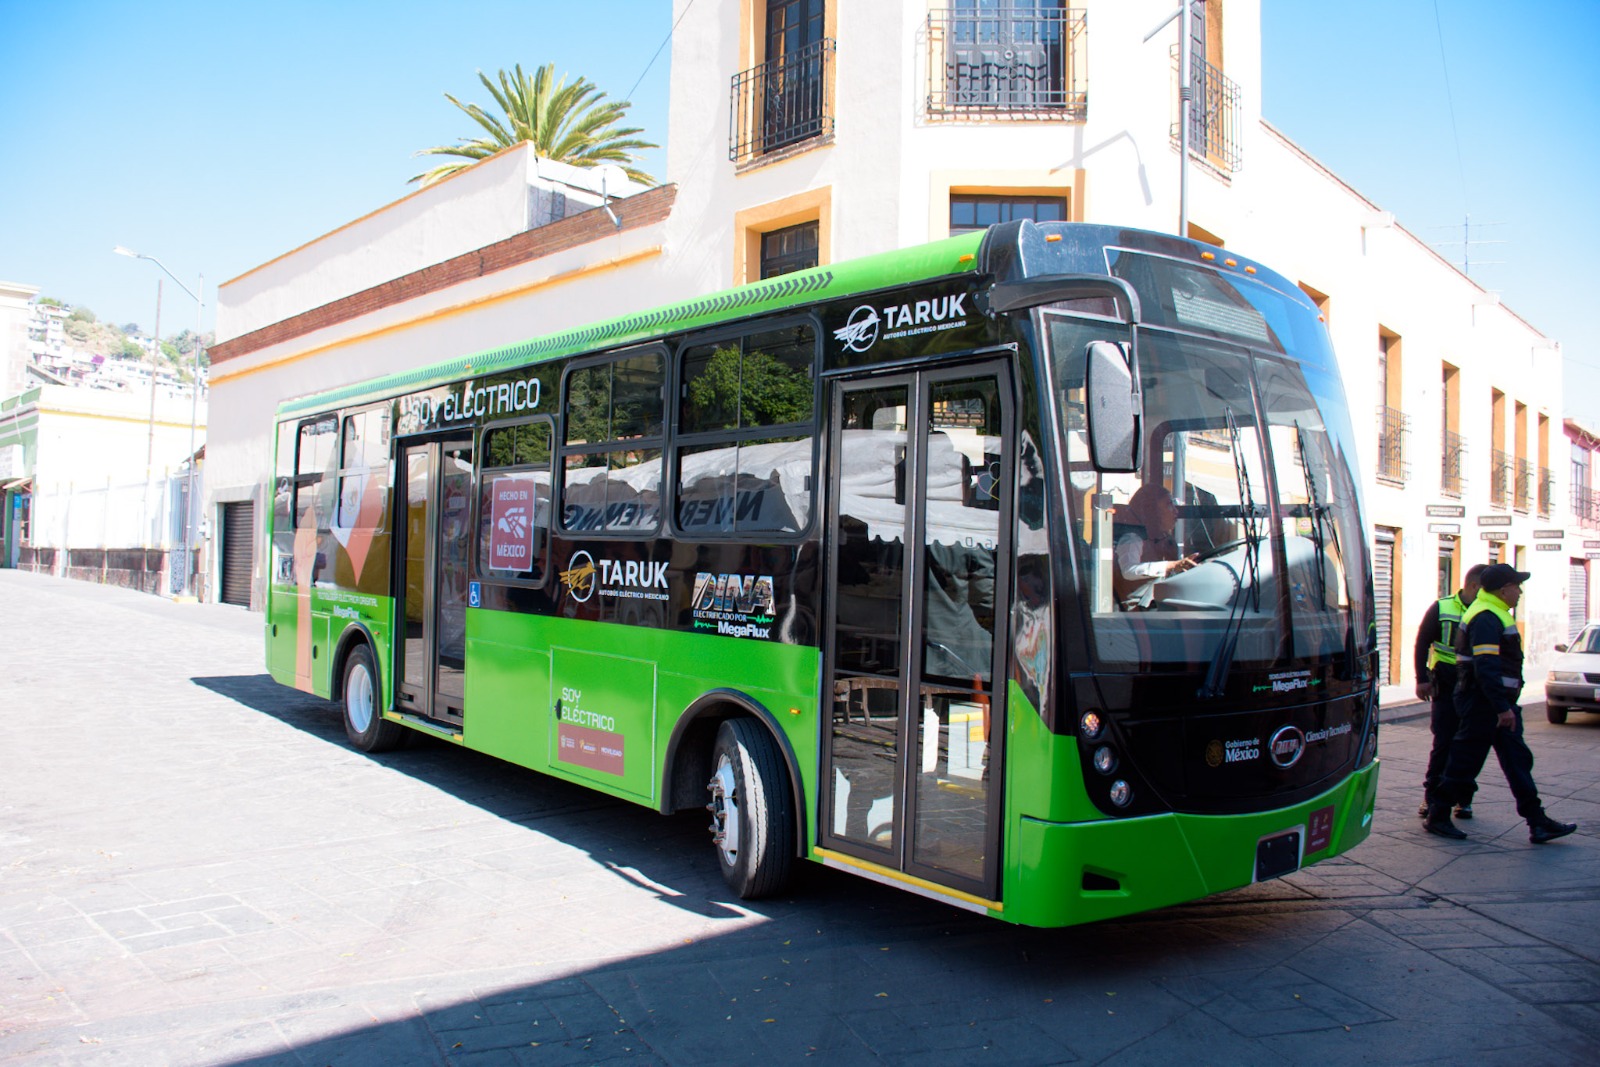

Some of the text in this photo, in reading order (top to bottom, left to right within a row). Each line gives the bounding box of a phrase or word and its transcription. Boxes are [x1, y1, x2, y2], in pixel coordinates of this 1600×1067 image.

[883, 292, 967, 330] TARUK
[907, 325, 937, 336] ELÉCTRICO
[937, 320, 967, 331] MEXICANO
[411, 378, 540, 426] SOY ELÉCTRICO
[499, 490, 528, 501] HECHO EN
[496, 542, 526, 558] MÉXICO
[599, 559, 669, 589] TARUK
[619, 590, 644, 599] ELÉCTRICO
[644, 592, 669, 601] MEXICANO
[691, 572, 776, 615] DINA
[693, 609, 747, 622] ELECTRIFICADO POR
[717, 620, 770, 639] MegaFlux
[1272, 678, 1308, 692] MegaFlux
[562, 687, 582, 703] SOY
[561, 704, 615, 732] ELÉCTRICO
[1225, 738, 1260, 749] Gobierno de
[1225, 746, 1260, 763] México
